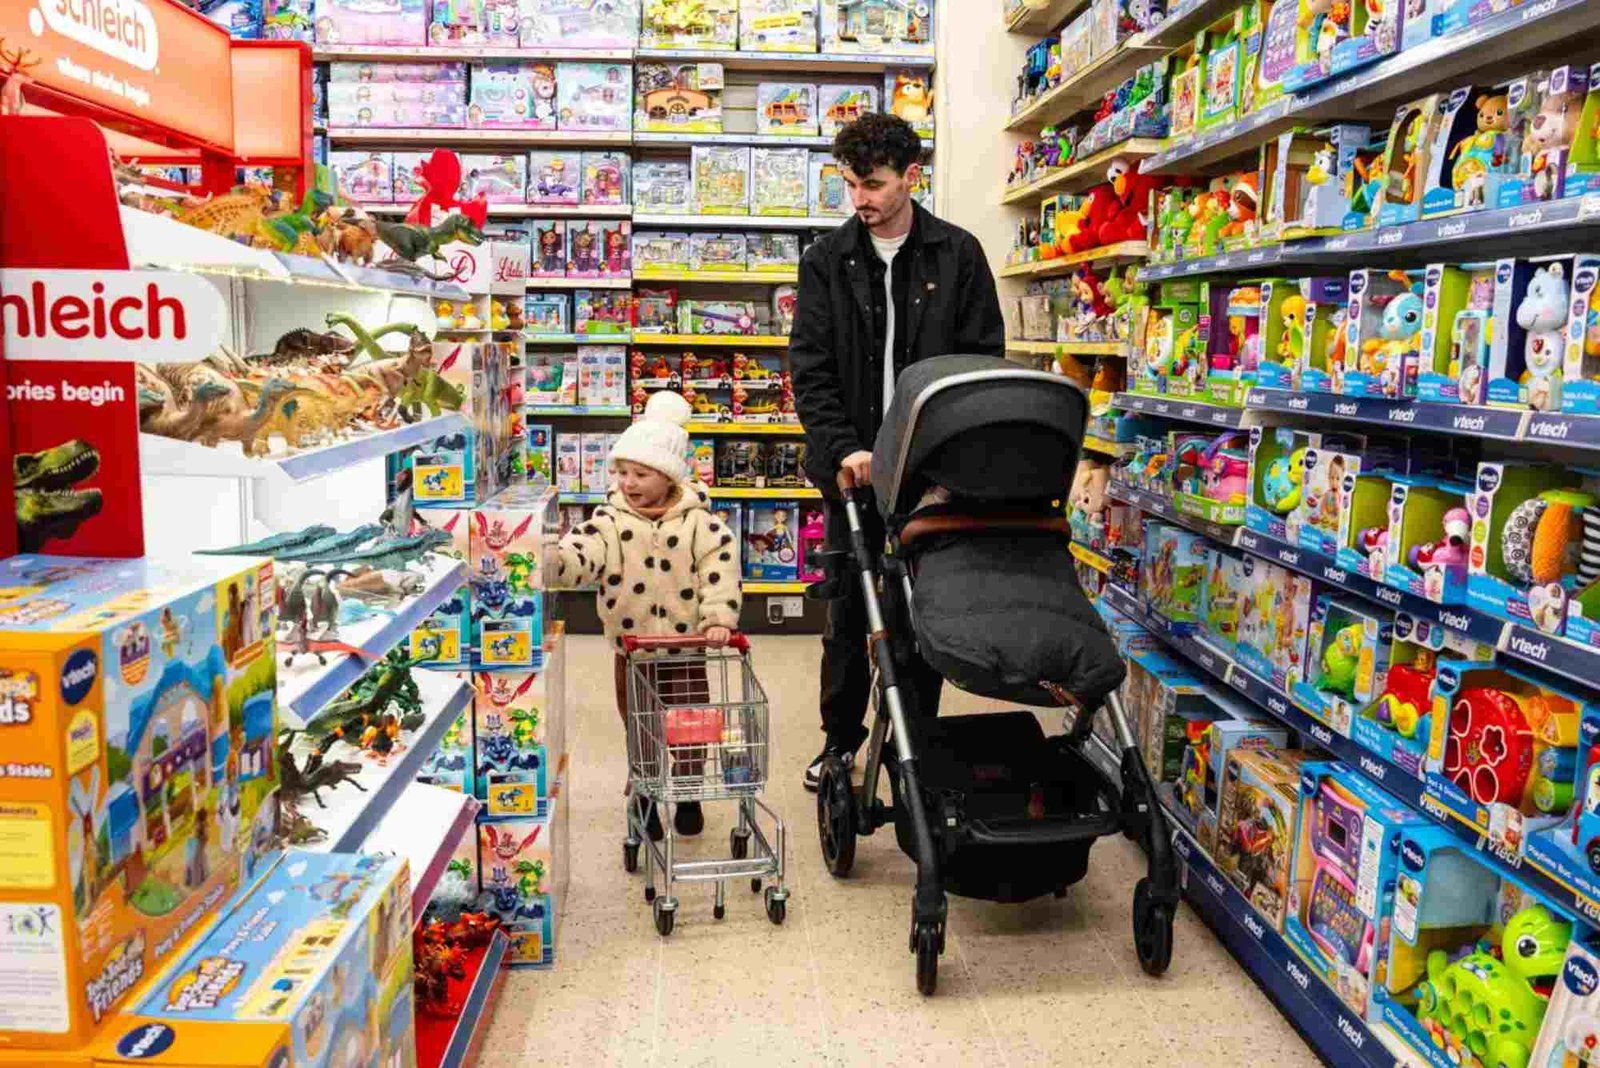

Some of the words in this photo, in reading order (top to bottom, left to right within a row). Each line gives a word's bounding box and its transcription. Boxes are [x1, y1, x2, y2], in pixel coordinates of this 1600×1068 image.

[1509, 209, 1543, 227] vtech
[1378, 230, 1404, 245] vtech
[1438, 221, 1467, 237] vtech
[62, 380, 124, 406] begin
[1289, 397, 1308, 409] vtech
[1334, 401, 1357, 416] vtech
[1388, 408, 1416, 423] vtech
[1453, 415, 1485, 431] vtech
[1530, 421, 1568, 439] vtech
[1279, 549, 1299, 564] vtech
[1323, 566, 1346, 583] vtech
[1376, 586, 1401, 604] vtech
[1439, 610, 1469, 631] vtech
[1511, 636, 1547, 659] vtech
[62, 659, 96, 689] vtech
[1268, 697, 1287, 715] vtech
[1310, 724, 1332, 745] vtech
[7, 763, 52, 778] Stable
[1360, 755, 1384, 779] vtech
[1402, 845, 1425, 867] vtech
[1243, 914, 1265, 939] vtech
[1286, 960, 1309, 990] vtech
[1567, 960, 1597, 987] vtech
[127, 1024, 167, 1057] vtech
[1337, 1014, 1364, 1049] vtech
